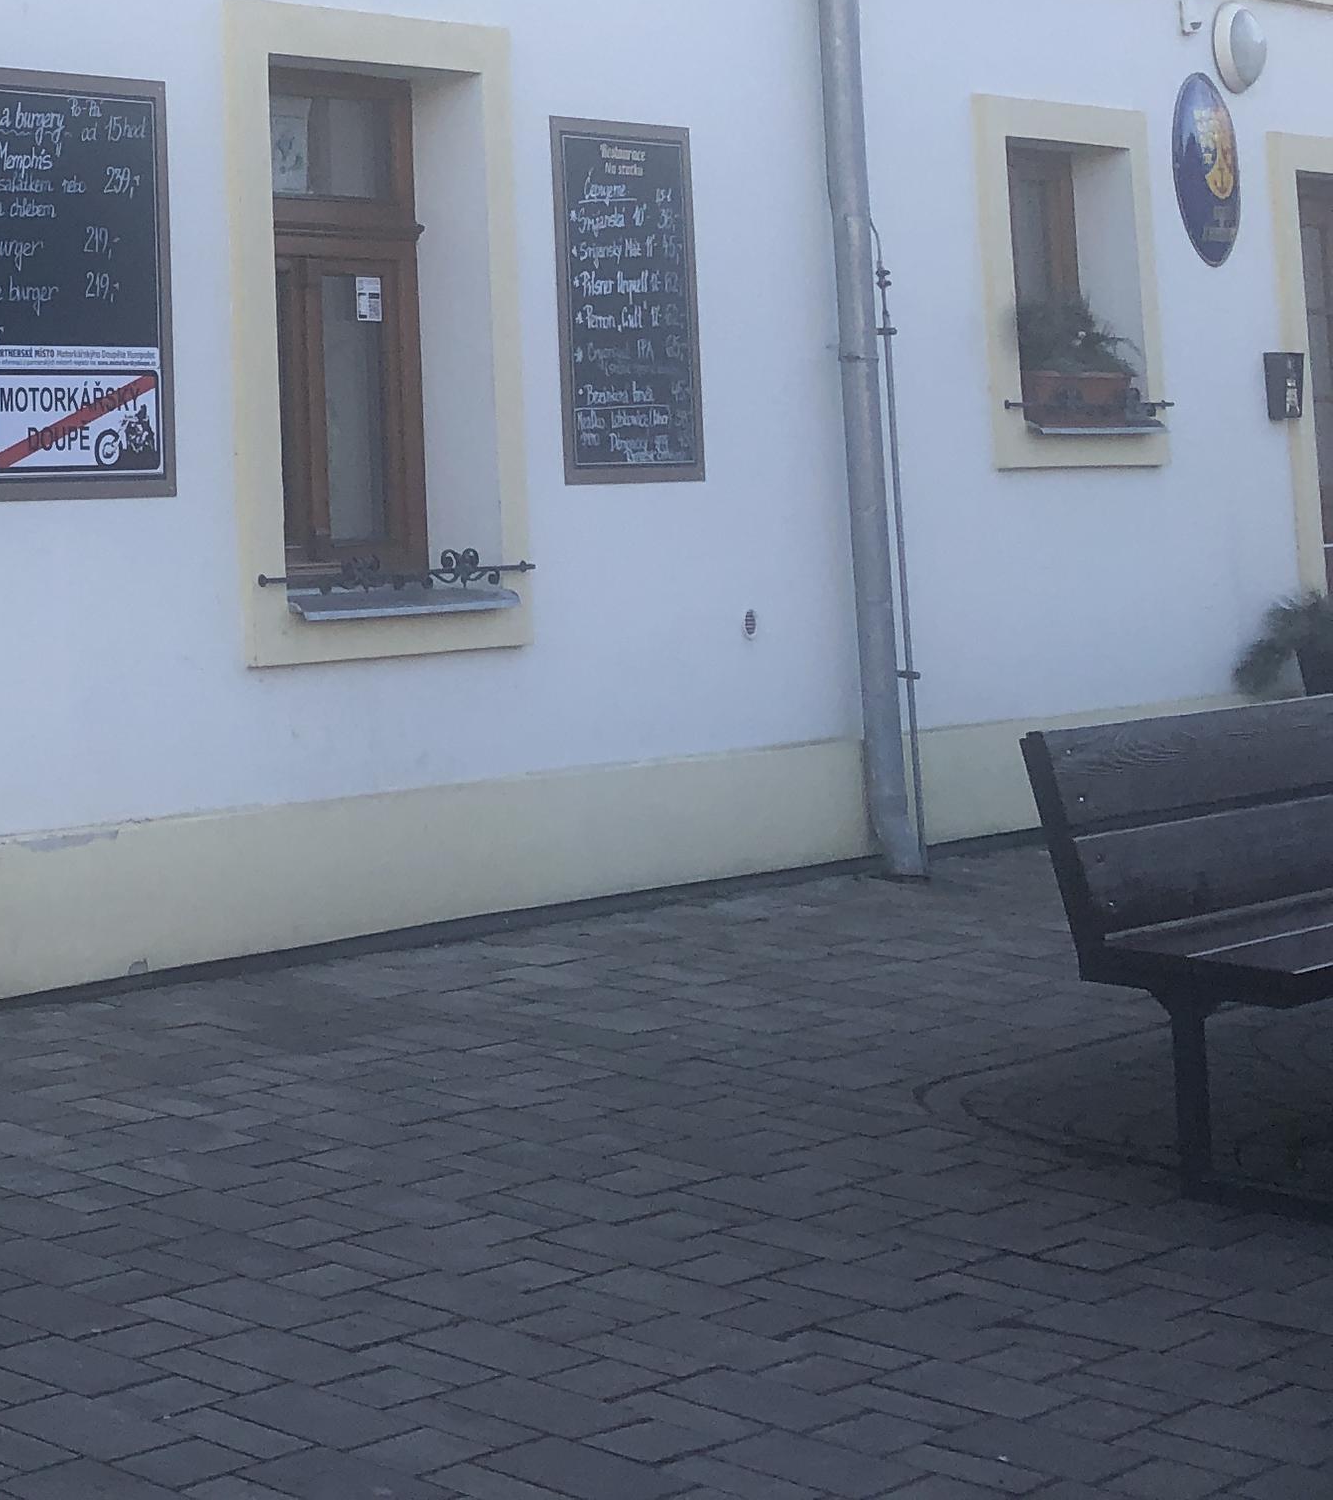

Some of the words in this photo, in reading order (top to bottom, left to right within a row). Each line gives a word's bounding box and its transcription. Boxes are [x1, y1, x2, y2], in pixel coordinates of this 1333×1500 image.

[0, 104, 15, 126] a
[15, 101, 65, 146] burgery
[61, 175, 87, 194] nebo
[9, 198, 58, 219] chlebem
[8, 275, 60, 317] burger
